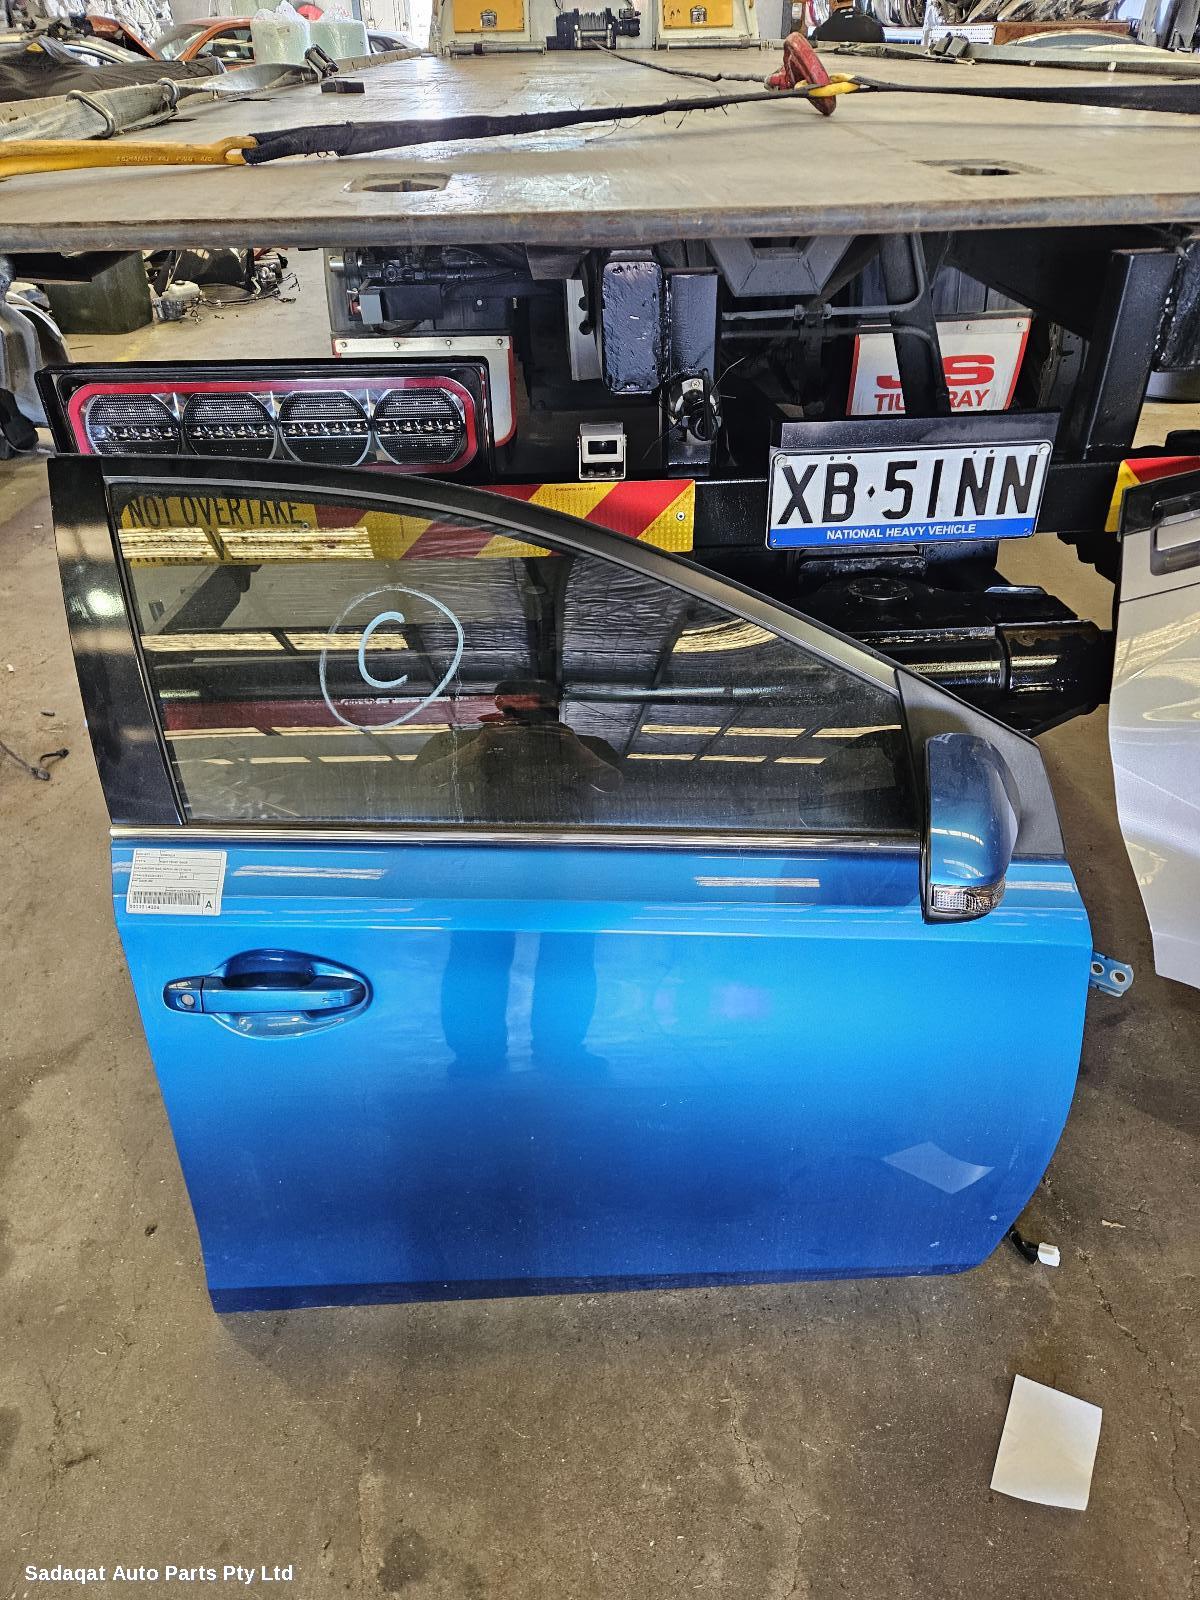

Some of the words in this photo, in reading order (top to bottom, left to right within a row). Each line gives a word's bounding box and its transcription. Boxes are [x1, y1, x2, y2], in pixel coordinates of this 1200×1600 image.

[949, 389, 990, 408] RAY
[179, 496, 305, 528] OVERTAKE
[826, 528, 883, 540] NATIONAL
[886, 526, 926, 537] HEAVY
[928, 523, 976, 535] VEHICLE
[357, 610, 409, 689] C
[205, 900, 212, 909] A
